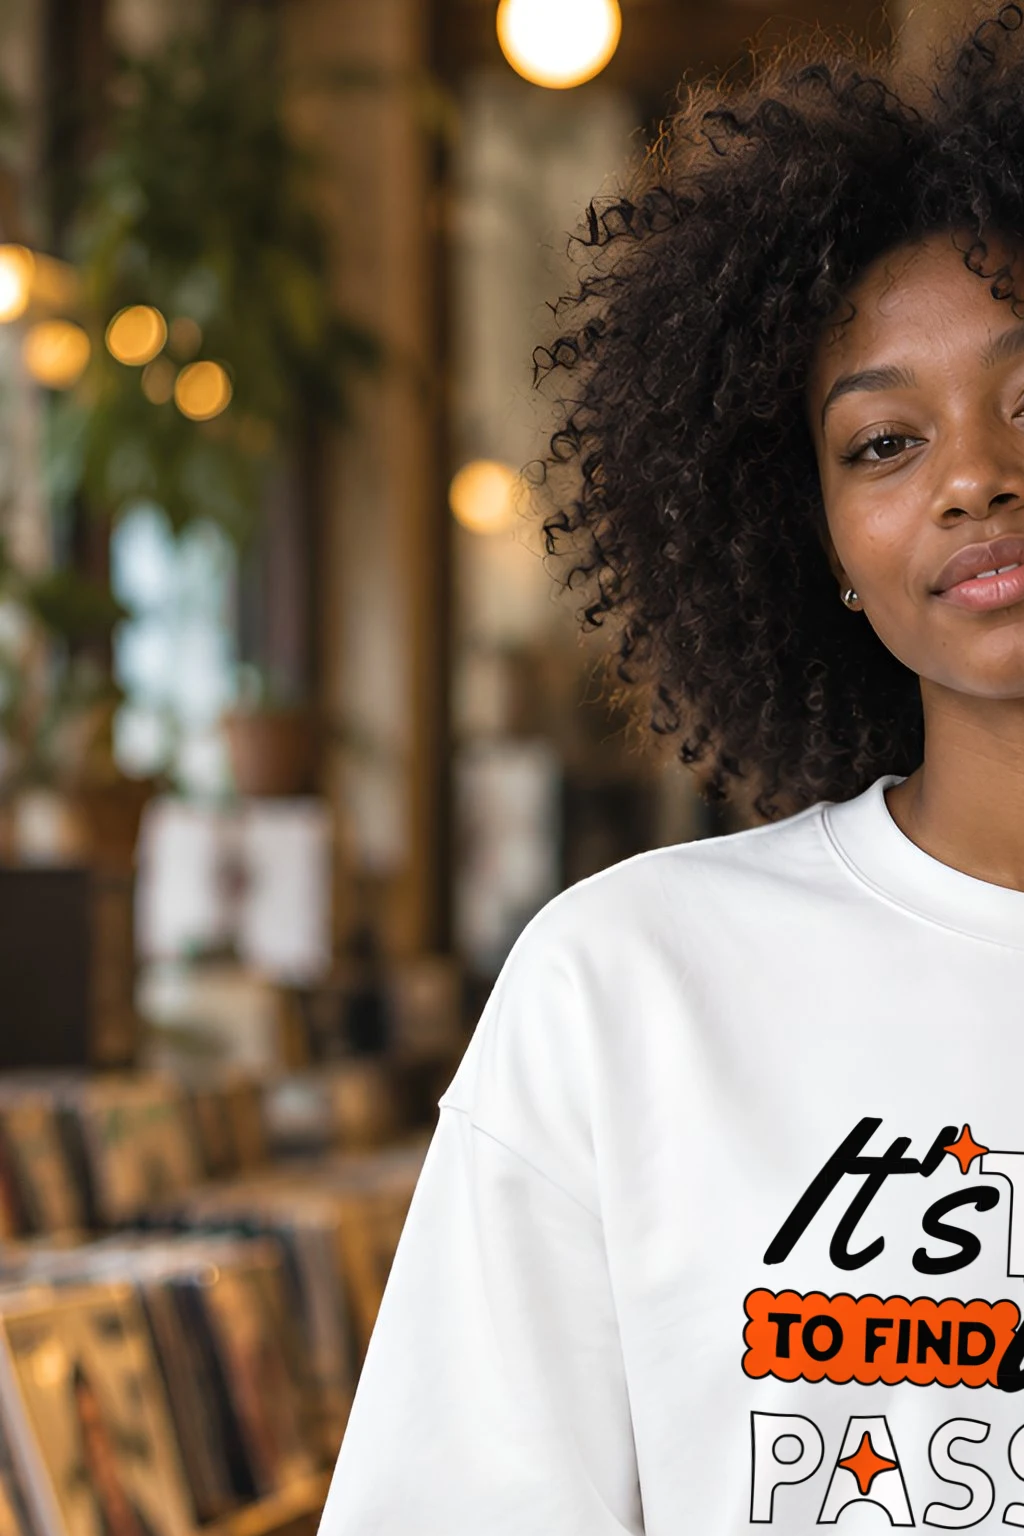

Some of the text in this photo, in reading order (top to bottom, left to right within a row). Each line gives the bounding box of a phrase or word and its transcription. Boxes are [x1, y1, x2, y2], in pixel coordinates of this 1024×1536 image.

[763, 1117, 1000, 1275] It's
[767, 1312, 844, 1362] TO
[864, 1318, 997, 1368] FIND
